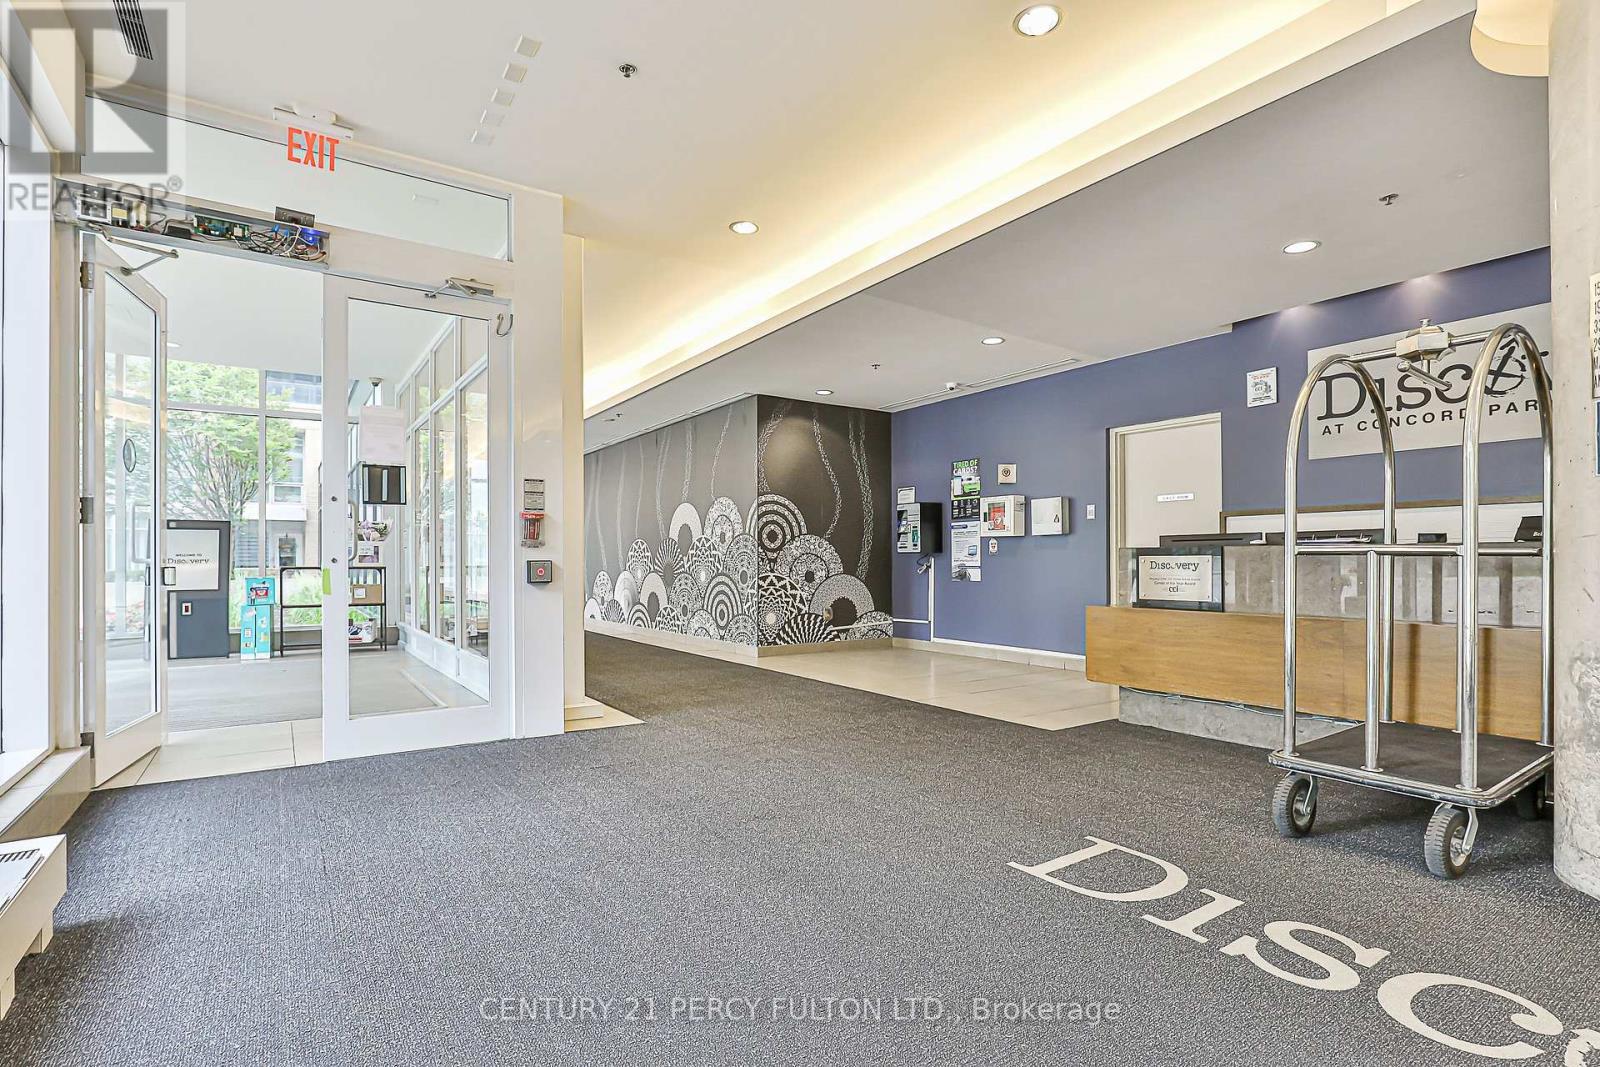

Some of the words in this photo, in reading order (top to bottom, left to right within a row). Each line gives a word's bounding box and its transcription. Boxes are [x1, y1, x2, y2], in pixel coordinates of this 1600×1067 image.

[287, 126, 340, 172] EXIT
[1322, 423, 1344, 436] AT
[1488, 399, 1539, 416] PAR
[953, 466, 977, 476] CARDS?
[969, 459, 978, 467] OF
[1150, 560, 1199, 571] Discovery
[1007, 836, 1600, 1067] Disc
